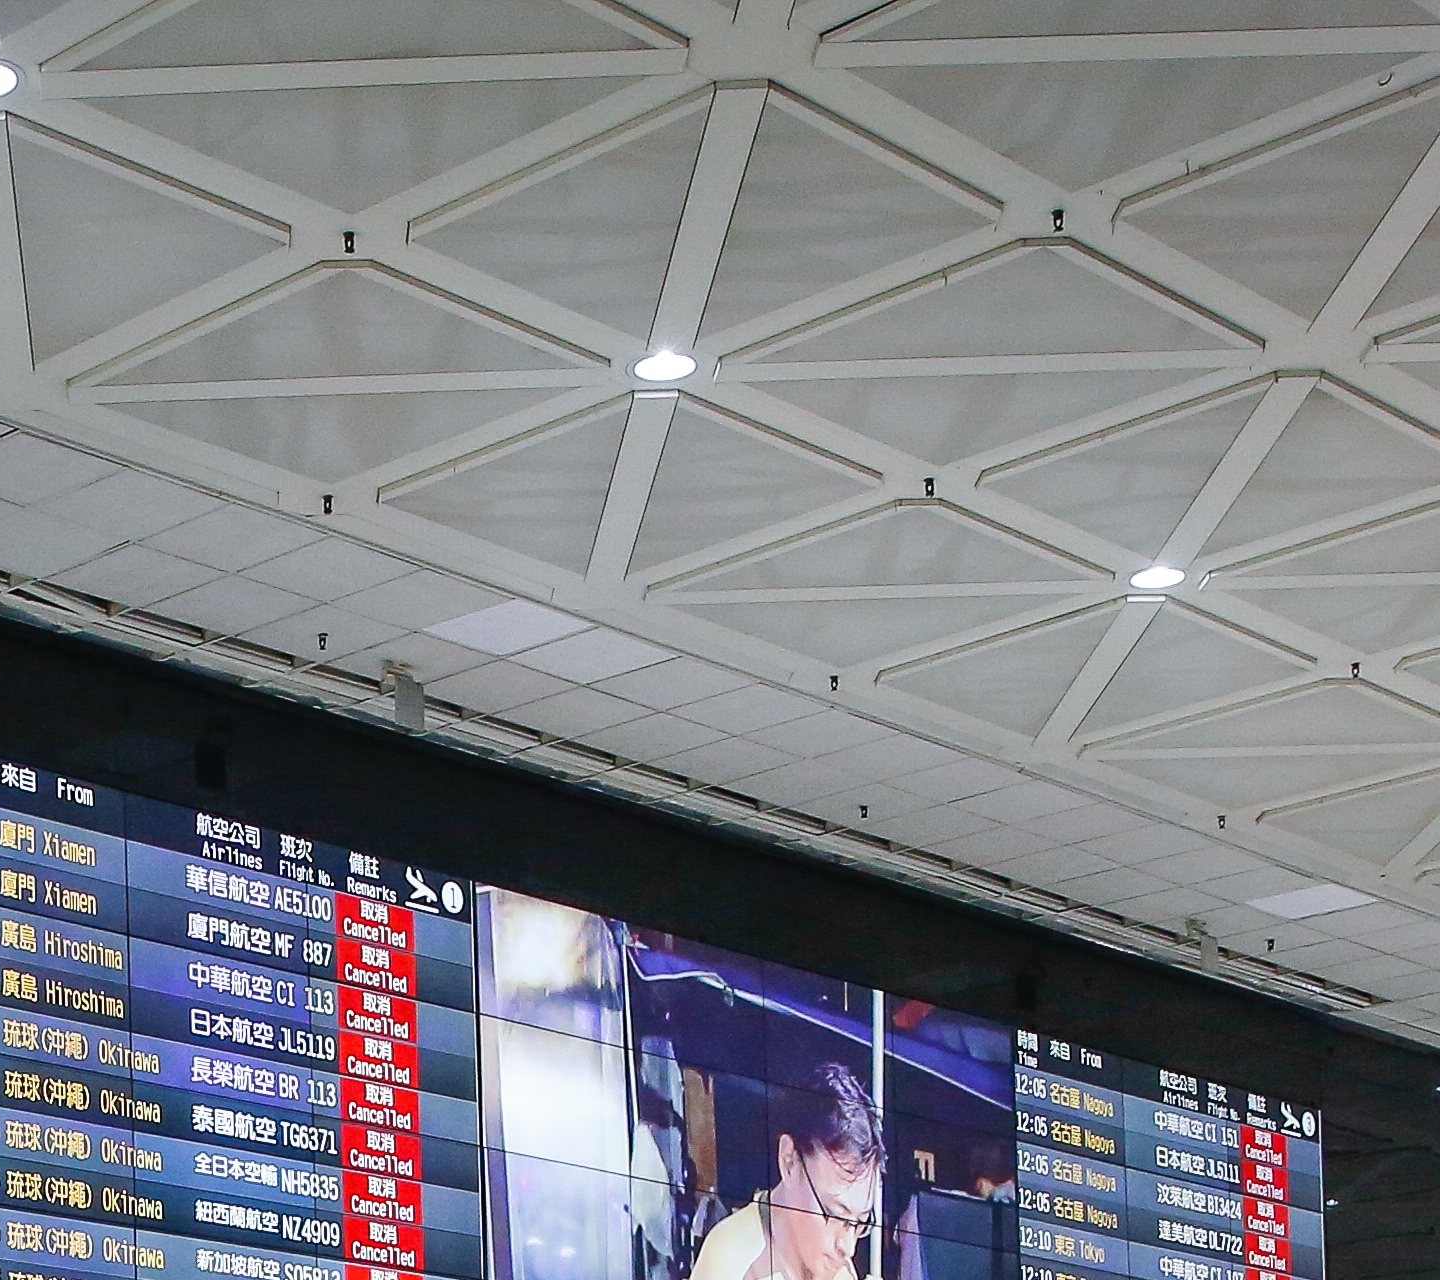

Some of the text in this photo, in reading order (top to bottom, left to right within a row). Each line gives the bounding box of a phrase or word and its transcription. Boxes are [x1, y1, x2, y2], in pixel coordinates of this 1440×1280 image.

[44, 830, 97, 866] Xiamen
[186, 865, 270, 908] 華信航空
[275, 886, 331, 921] AE5100
[1, 920, 36, 952] 廣島
[45, 930, 122, 969] Hiroshima
[189, 962, 273, 1002] 中華航空
[277, 981, 294, 1006] CI
[305, 988, 333, 1014] 113
[3, 1020, 91, 1060] 琉球(沖繩)
[99, 1037, 159, 1073] Okinawa
[191, 1054, 277, 1095] 長榮航空
[279, 1074, 298, 1100] BR
[308, 1080, 336, 1106] 113
[1015, 1071, 1239, 1148] 12:05 名古屋 Nagoya 中華航空 CI 151
[6, 1121, 93, 1159] 琉球(沖繩)
[102, 1139, 161, 1171] Okinawa
[195, 1153, 277, 1186] 全日本空輸
[282, 1168, 338, 1200] NH5835
